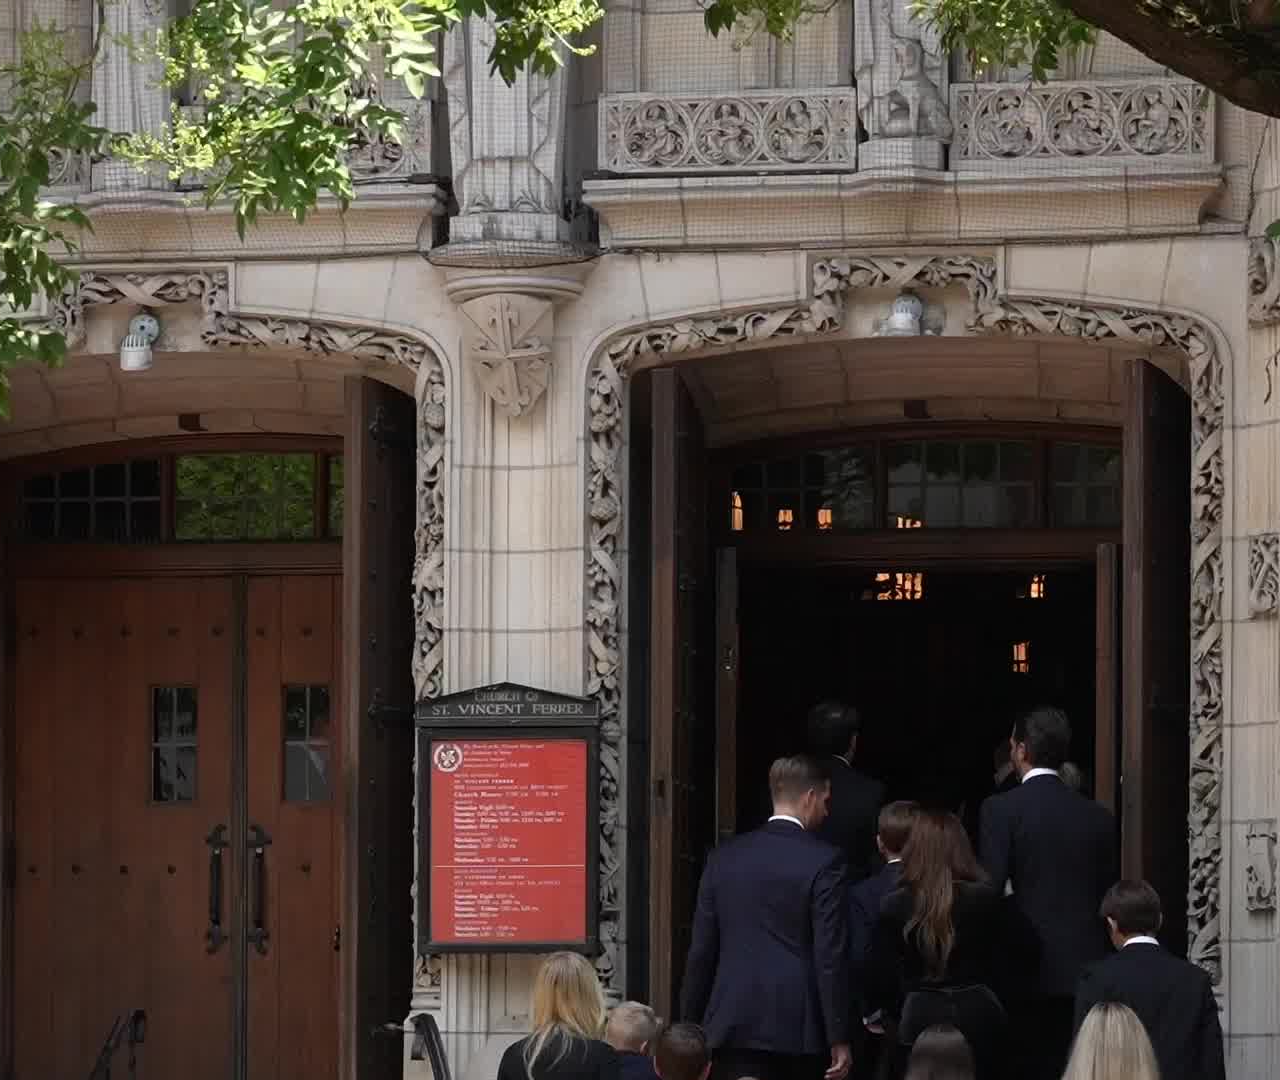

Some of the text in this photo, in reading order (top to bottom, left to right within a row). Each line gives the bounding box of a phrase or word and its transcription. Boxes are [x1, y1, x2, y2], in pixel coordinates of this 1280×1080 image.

[474, 690, 520, 702] CHURCH
[432, 703, 585, 716] ST. VINCENT FERRER
